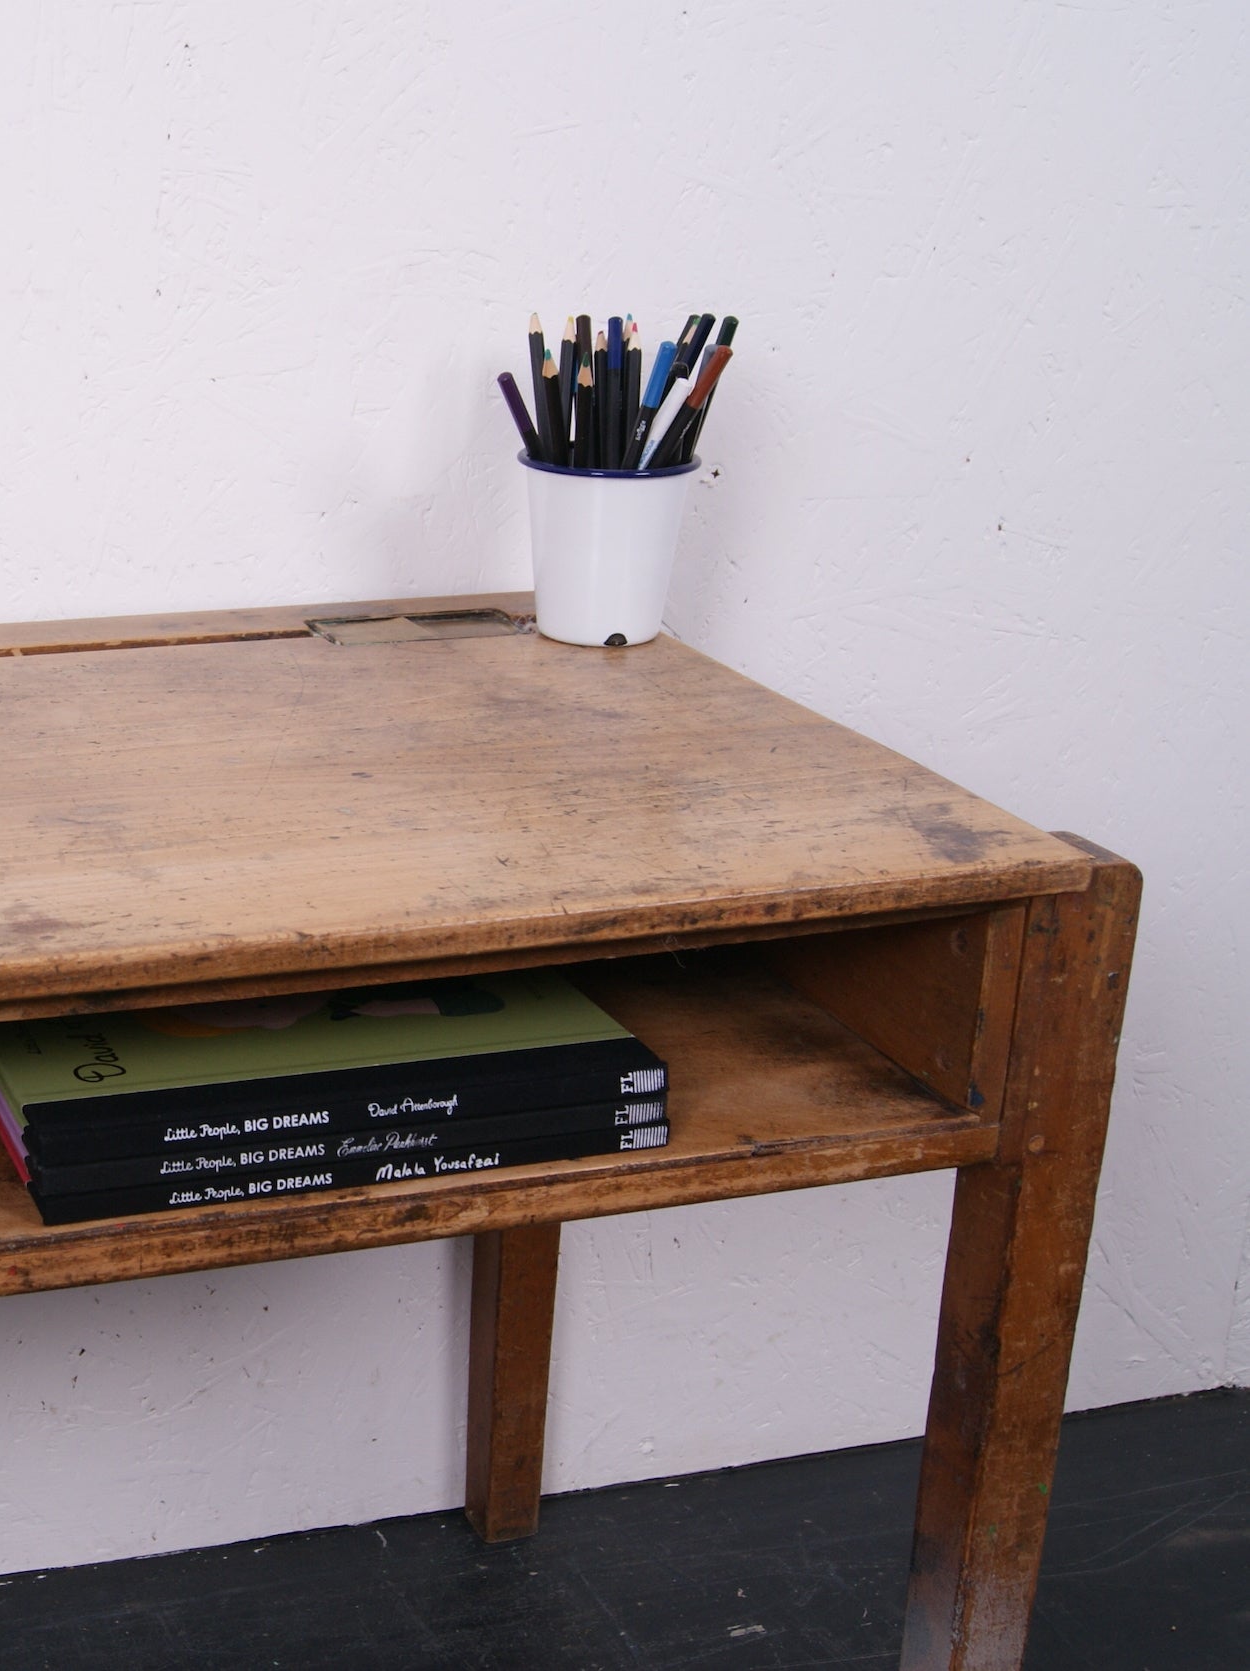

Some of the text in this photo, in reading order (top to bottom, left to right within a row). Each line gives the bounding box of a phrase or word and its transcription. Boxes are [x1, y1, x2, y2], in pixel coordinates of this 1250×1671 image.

[164, 1127, 198, 1142] Little
[199, 1122, 241, 1140] People,
[244, 1118, 269, 1133] BIG
[273, 1110, 330, 1129] DREAMS
[367, 1102, 398, 1118] David
[160, 1160, 194, 1175] Little
[195, 1155, 237, 1173] People,
[240, 1151, 265, 1165] BIG
[268, 1143, 326, 1162] DREAMS
[169, 1152, 501, 1205] Little People, BIG DREAMS Malala Yousafzai
